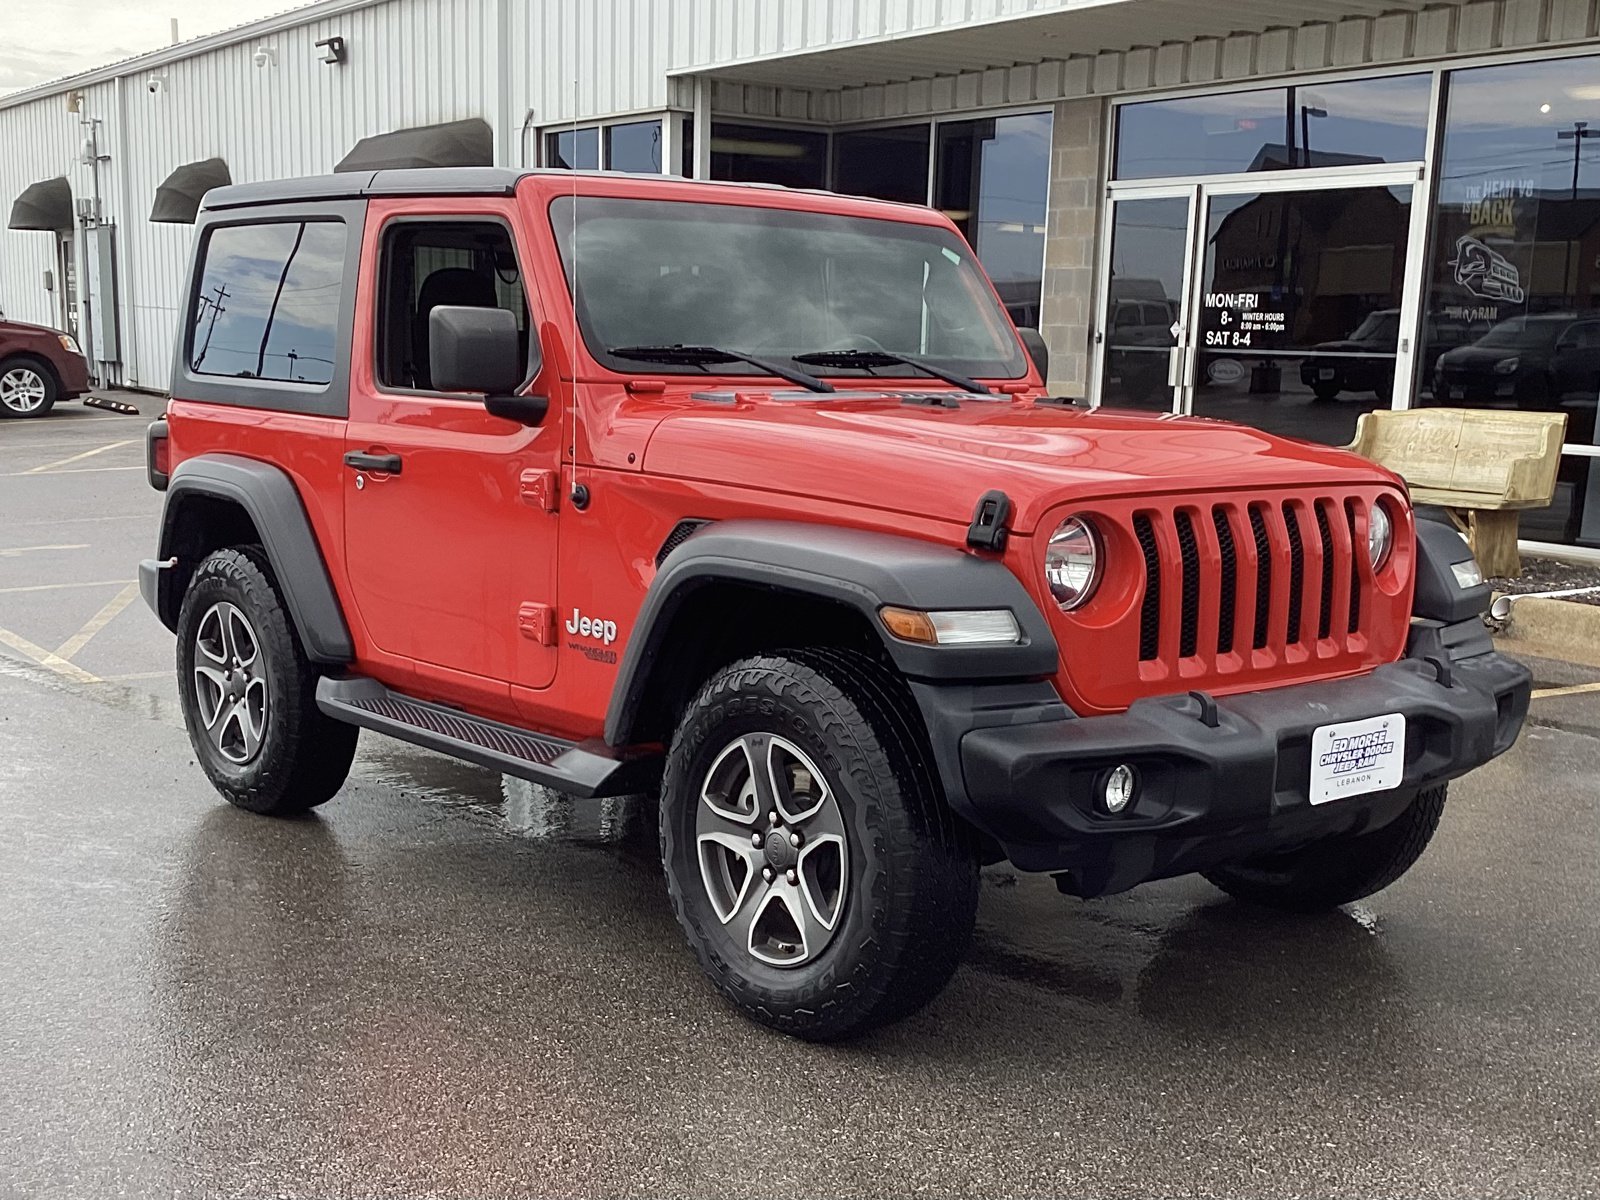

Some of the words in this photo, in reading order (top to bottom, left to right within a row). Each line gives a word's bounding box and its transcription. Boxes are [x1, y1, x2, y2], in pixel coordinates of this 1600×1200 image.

[1466, 185, 1482, 198] THE
[1483, 179, 1515, 199] HEMI
[1518, 178, 1534, 198] V8
[1462, 201, 1471, 214] IS
[1470, 199, 1516, 225] BACK
[1205, 293, 1259, 308] MON-FRI
[1242, 312, 1264, 321] WINTER
[1264, 312, 1285, 322] HOURS
[1478, 306, 1498, 320] RAM
[1205, 330, 1231, 346] SAT
[1232, 331, 1251, 347] 8-4
[565, 607, 617, 646] Jeep
[1331, 738, 1348, 754] ED
[1348, 730, 1388, 752] MORSE
[1336, 774, 1372, 787] LEBANON
